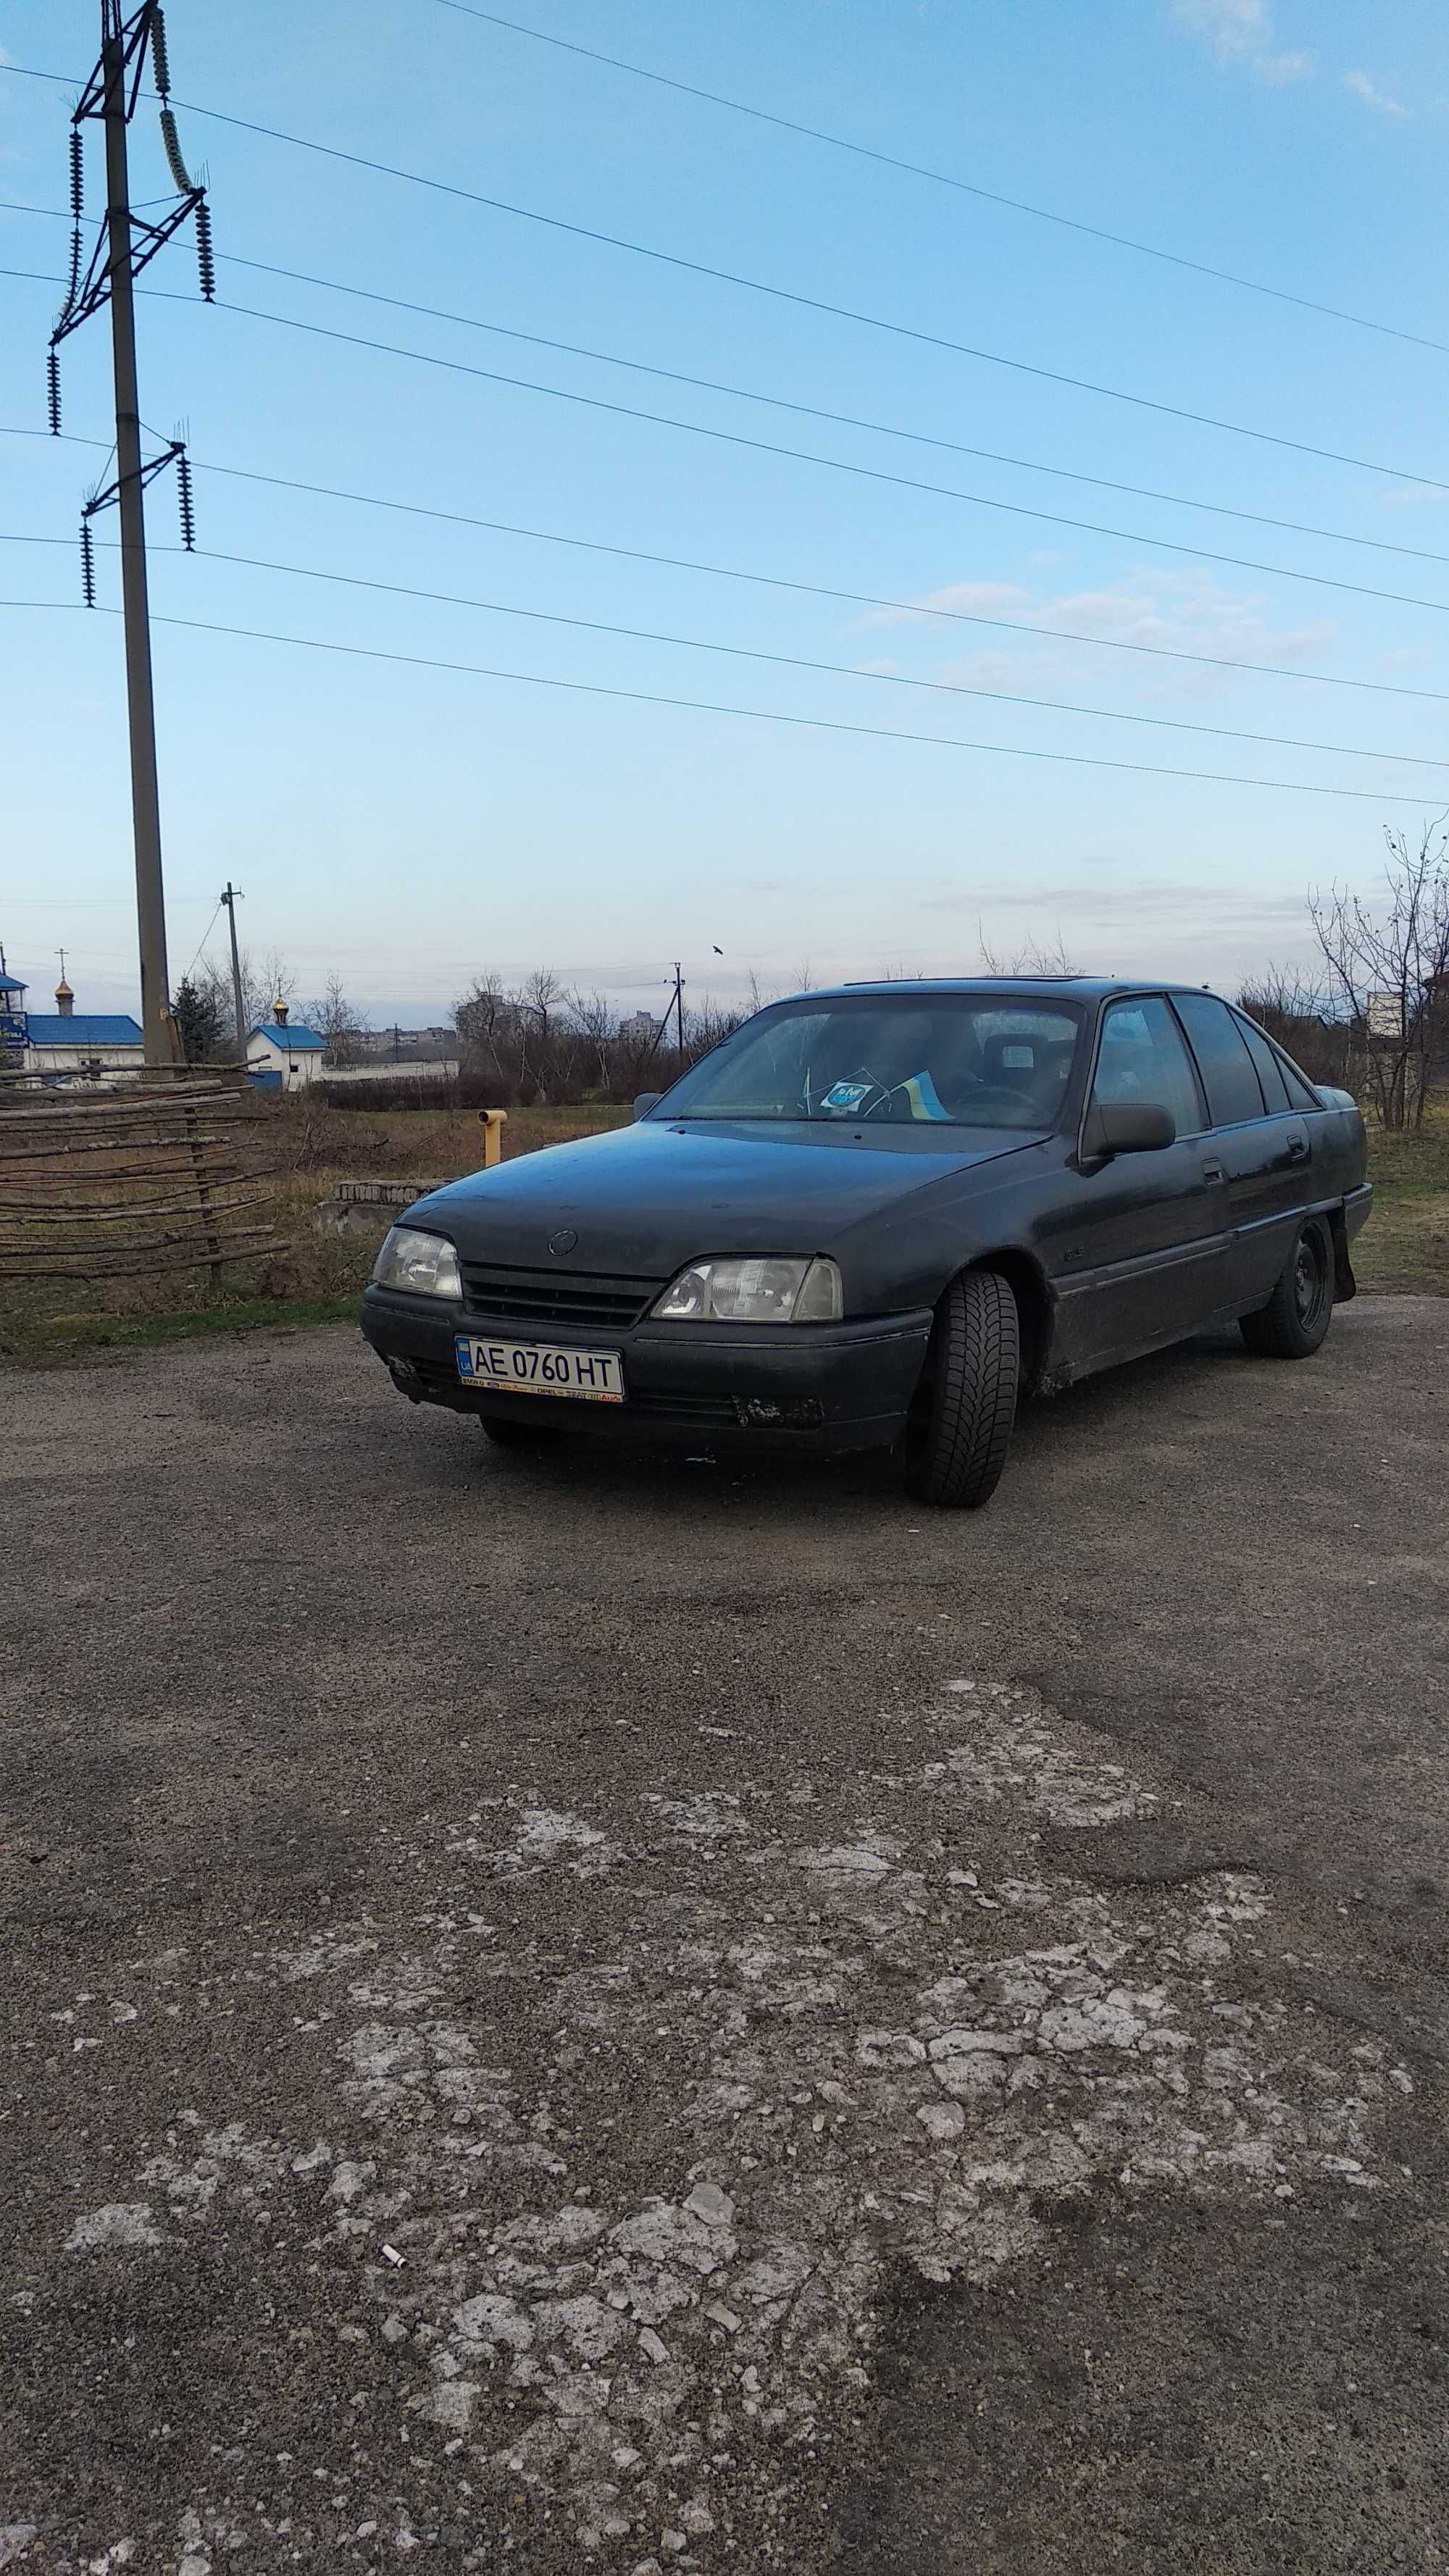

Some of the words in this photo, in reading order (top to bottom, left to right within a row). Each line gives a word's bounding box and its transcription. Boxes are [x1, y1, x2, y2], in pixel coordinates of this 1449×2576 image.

[475, 1345, 509, 1376] AE
[512, 1350, 569, 1383] 0760
[575, 1355, 612, 1387] HT
[537, 1387, 558, 1396] OPEL
